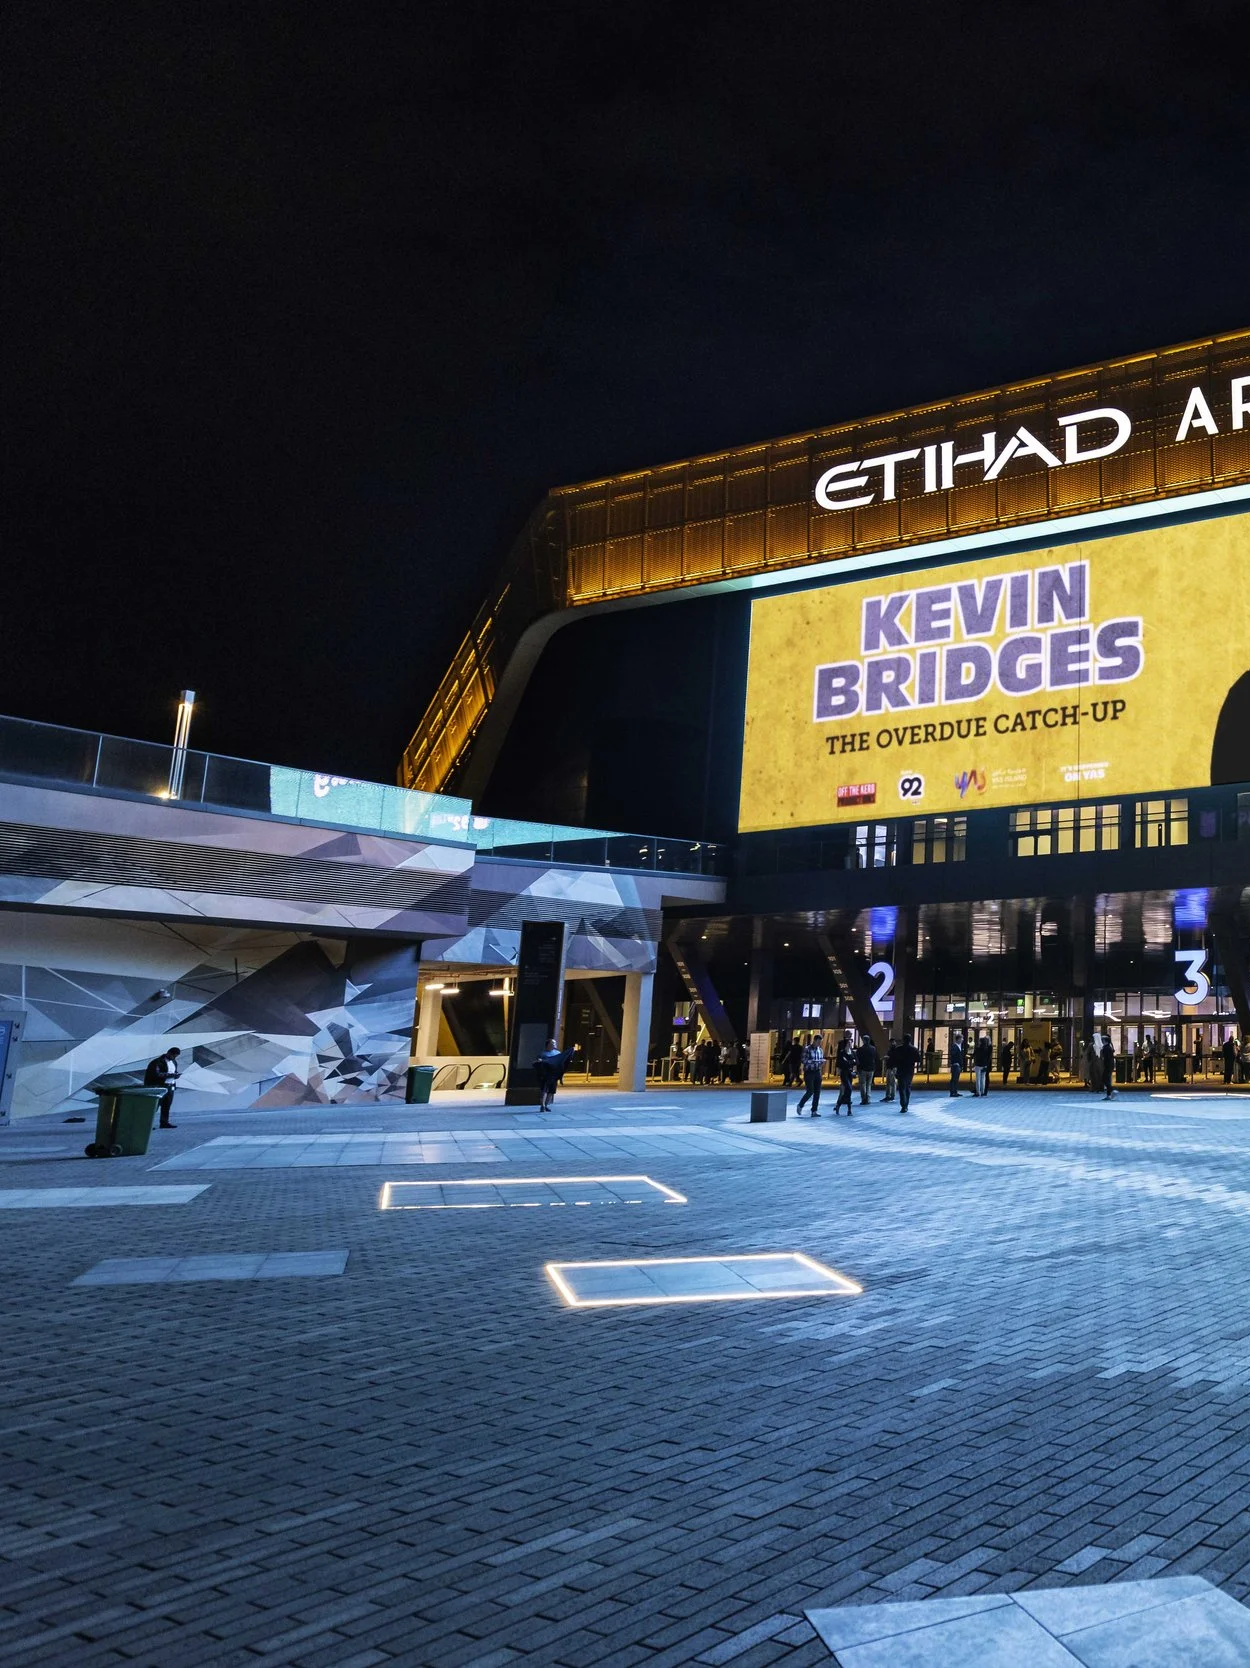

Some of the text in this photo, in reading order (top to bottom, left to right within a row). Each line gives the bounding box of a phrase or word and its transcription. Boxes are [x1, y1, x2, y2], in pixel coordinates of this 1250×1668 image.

[814, 406, 1134, 511] ETIHAD
[860, 559, 1091, 657] KEVIN
[812, 616, 1145, 723] BRIDGES
[826, 698, 1127, 756] THE OVERDUE CATCH-UP
[901, 777, 923, 797] 92
[867, 961, 895, 1012] 2
[1173, 949, 1212, 1006] 3
[986, 1011, 995, 1025] 2
